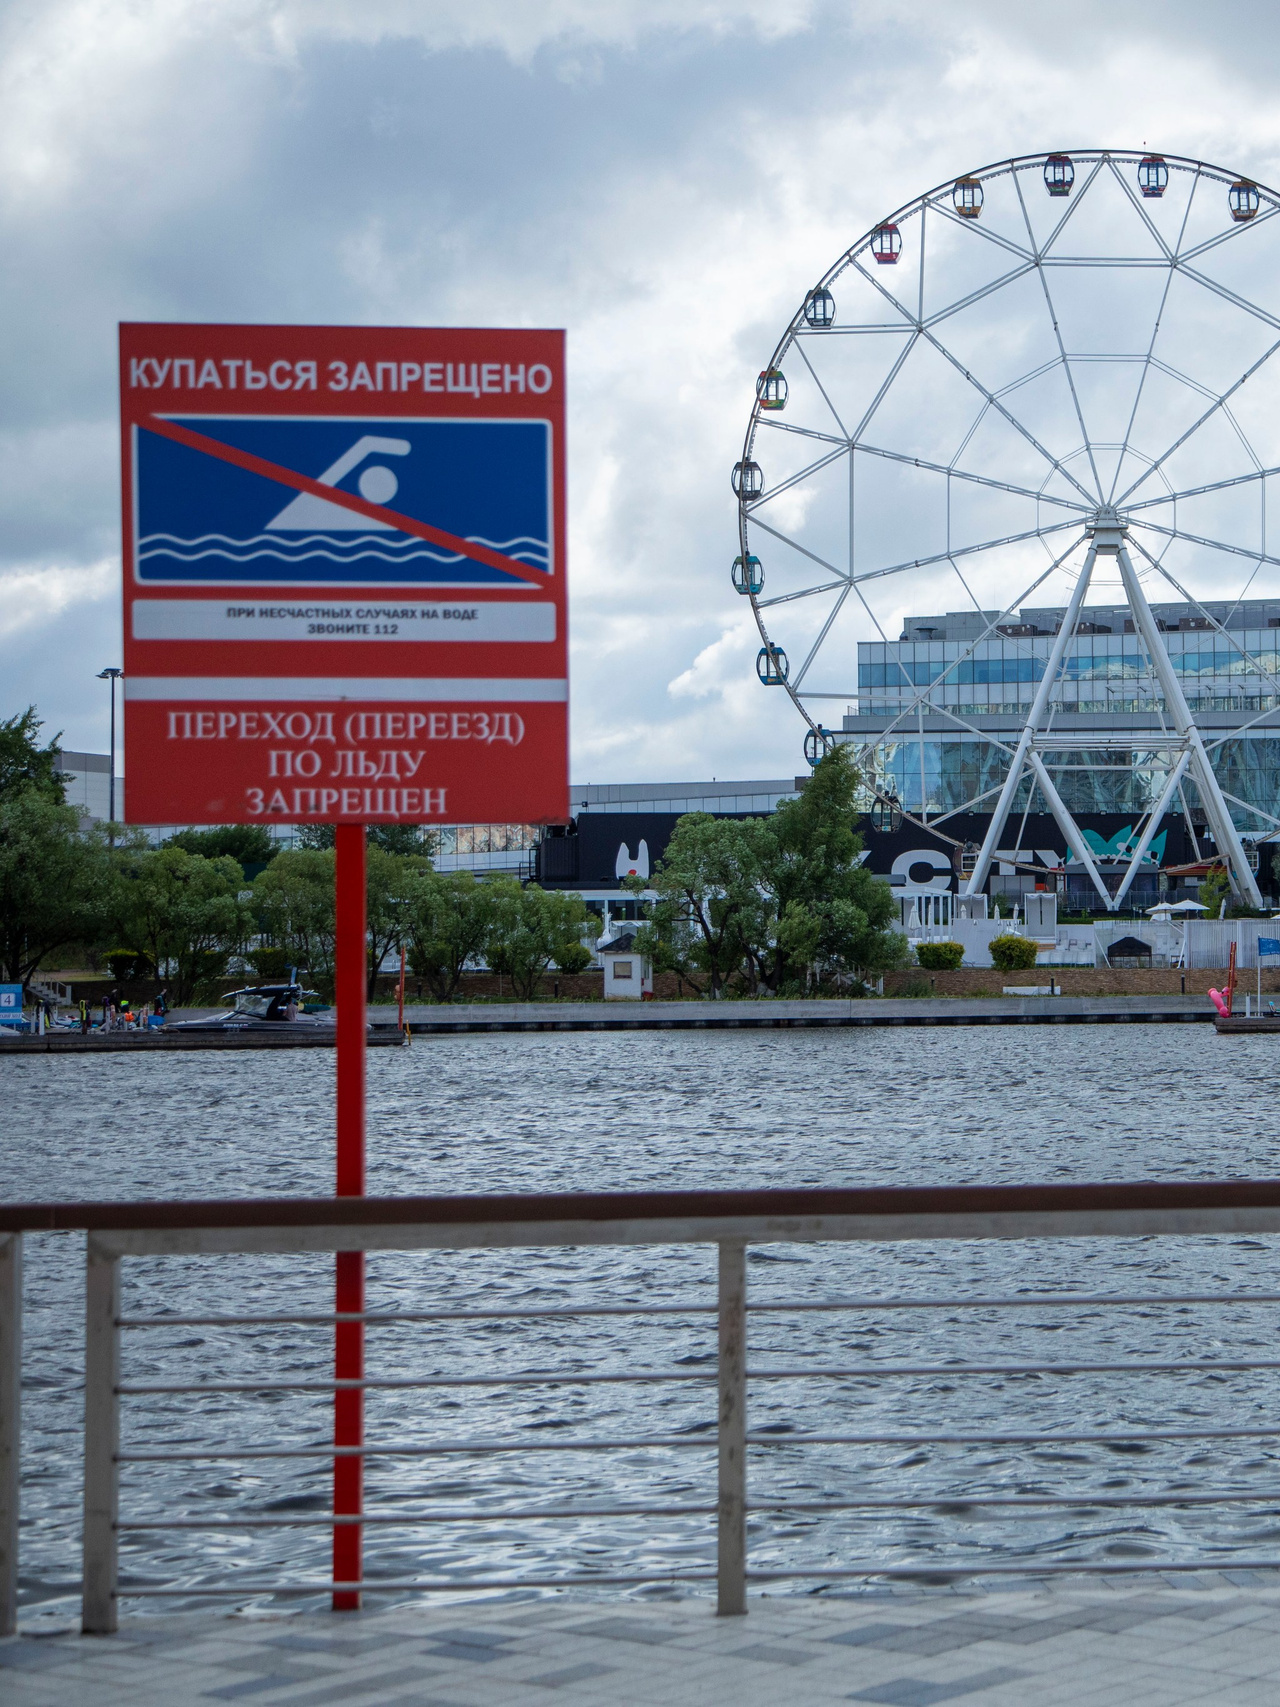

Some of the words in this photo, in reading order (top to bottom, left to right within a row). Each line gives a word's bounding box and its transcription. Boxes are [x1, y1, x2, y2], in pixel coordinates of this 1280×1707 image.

[130, 358, 317, 390] КУПАТЬСЯ
[329, 361, 552, 397] ЗАПРЕЩЕНО
[226, 607, 256, 618] ПРИ
[258, 607, 352, 619] НЕСЧАСТНЫХ
[355, 608, 417, 619] СЛУЧАЯХ
[421, 609, 440, 619] НА
[443, 609, 479, 621] ВОДЕ
[308, 623, 370, 635] ЗВОНИТЕ
[374, 624, 398, 635] 112
[168, 712, 336, 743] ПЕРЕХОД
[345, 712, 525, 744] (ПЕРЕЕЗД)
[270, 750, 322, 777] ПО
[331, 750, 425, 781] ЛЬДУ
[247, 788, 446, 817] ЗАПРЕЩЕН
[3, 994, 12, 1005] 4
